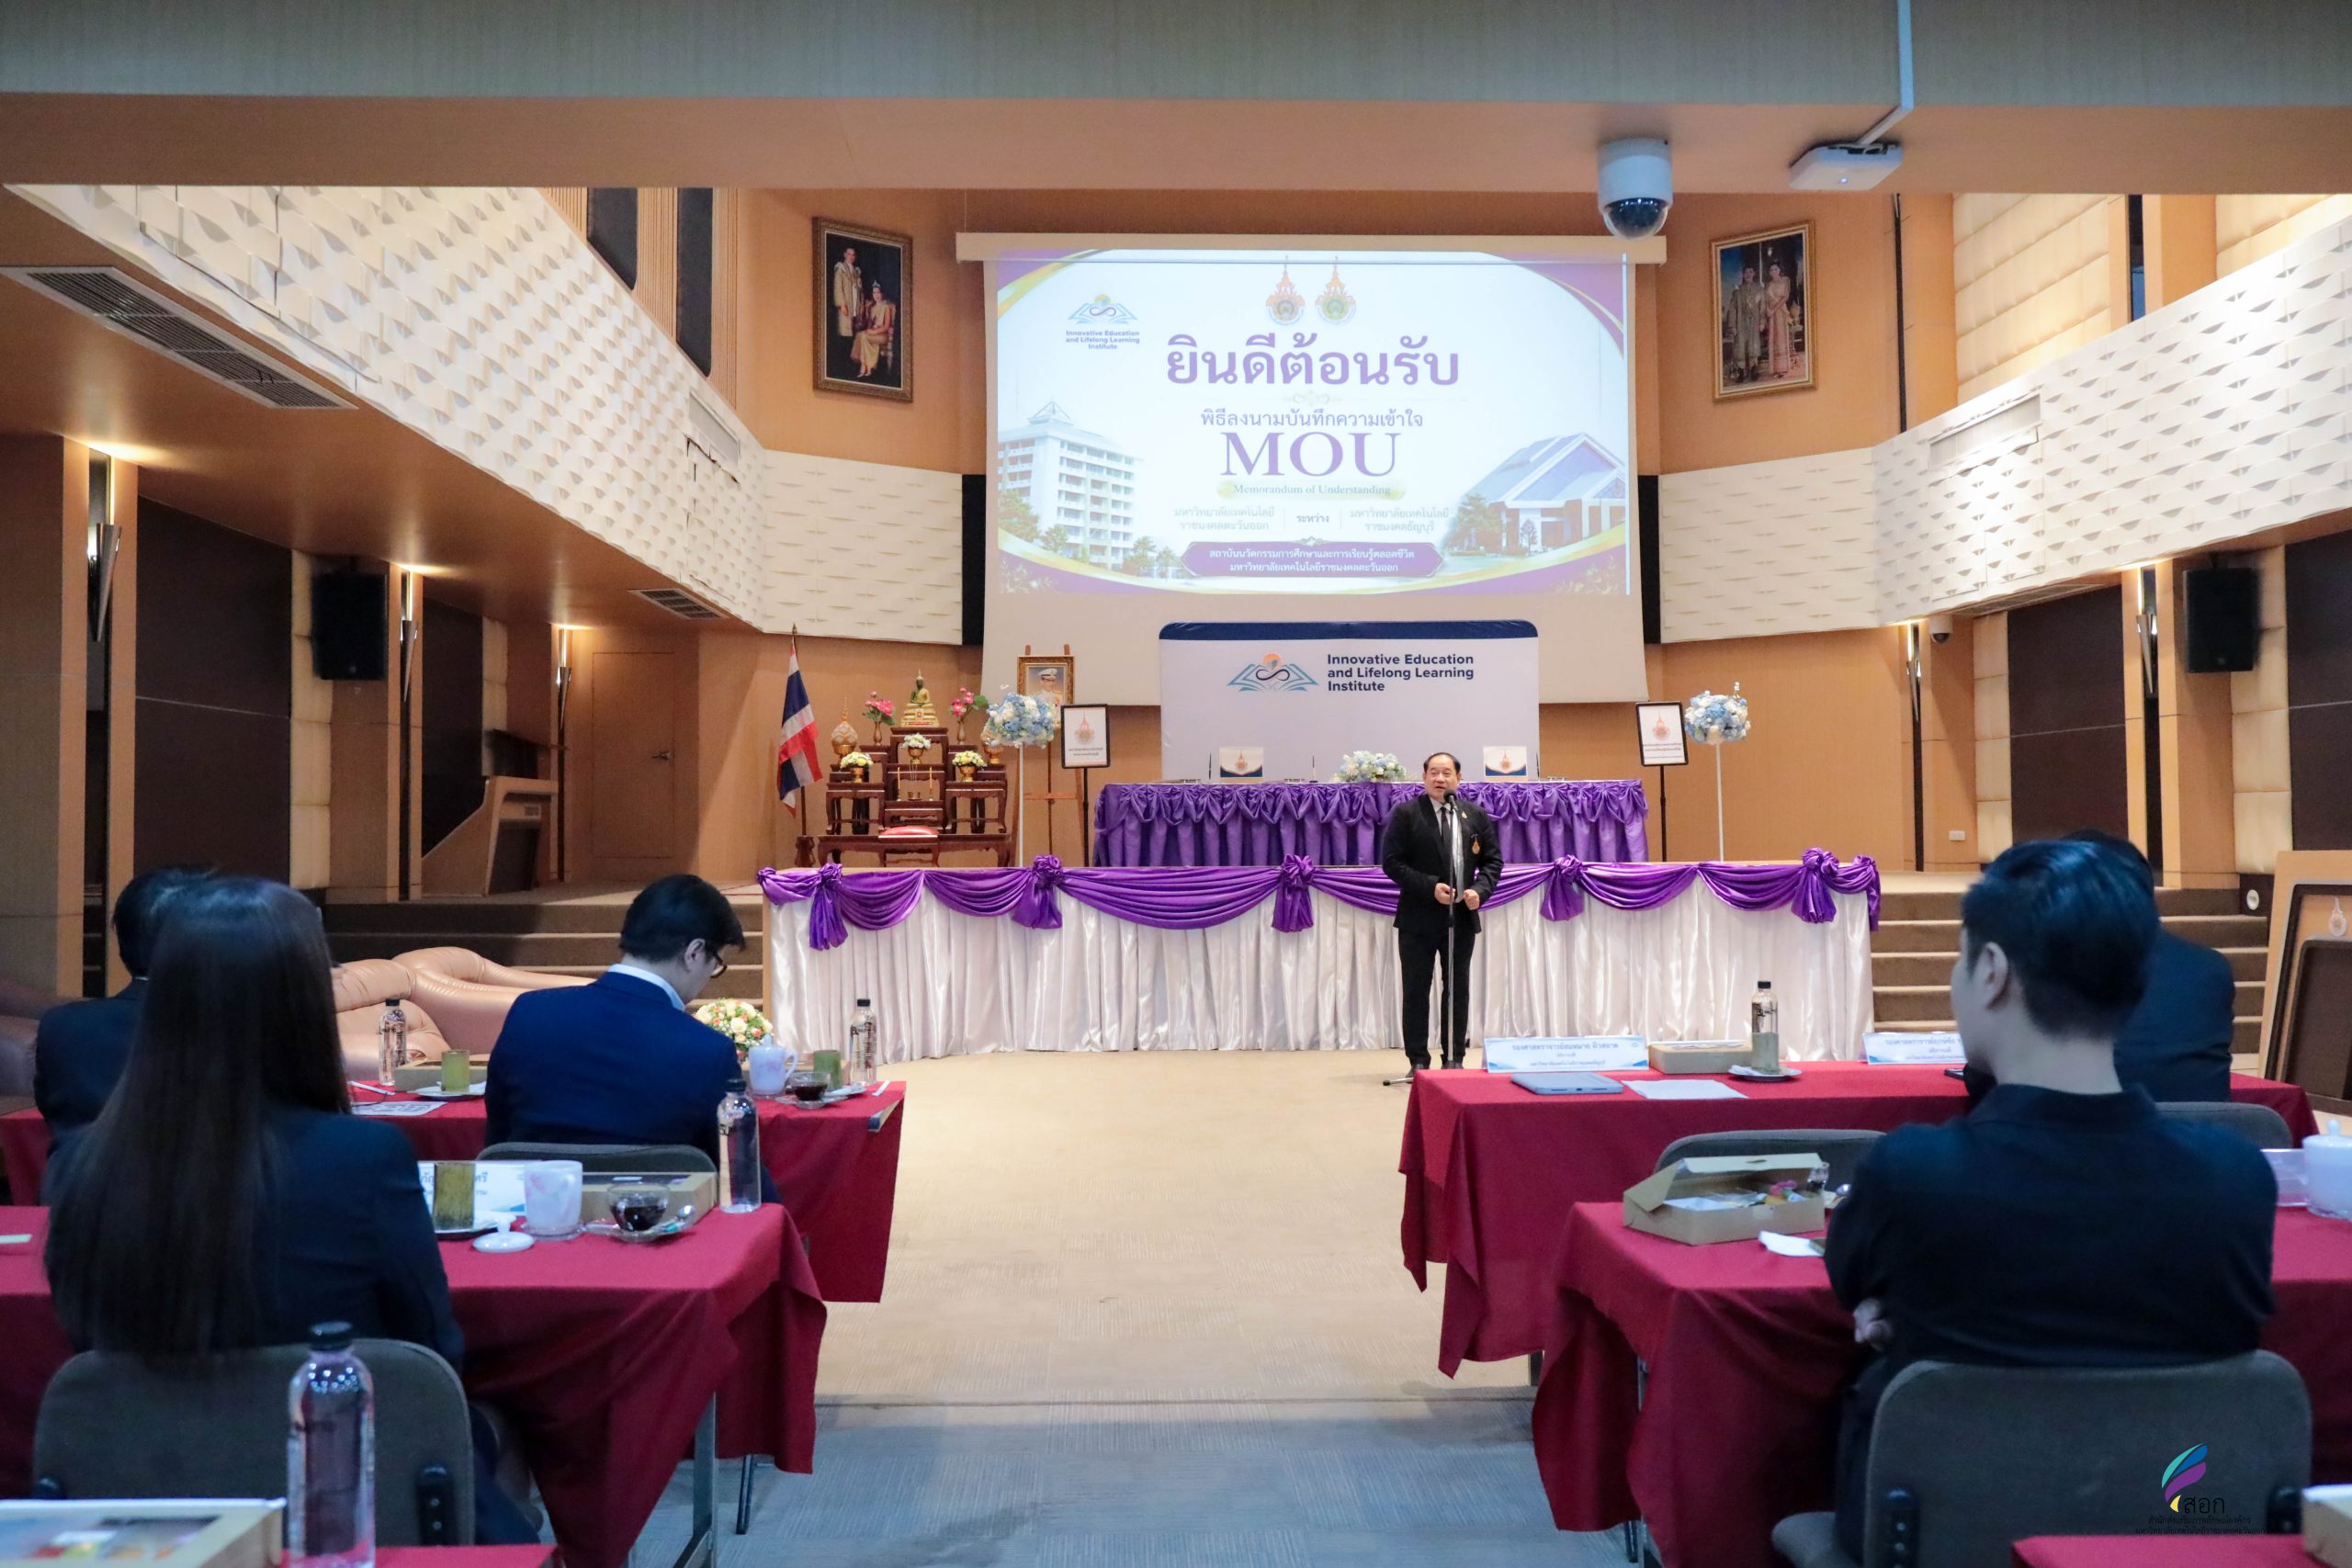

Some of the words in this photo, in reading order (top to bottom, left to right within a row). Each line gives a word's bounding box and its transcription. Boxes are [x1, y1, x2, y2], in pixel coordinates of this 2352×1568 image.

[1167, 332, 1459, 386] ยินดีต้อนรับ
[1201, 408, 1423, 427] พิธีลงนามบันทึกความเข้าใจ
[1220, 432, 1402, 477] MOU
[1233, 485, 1303, 494] Memorandum
[1306, 484, 1317, 494] of
[1318, 484, 1391, 496] Understanding
[1296, 513, 1329, 523] ระหว่าง
[1209, 548, 1415, 560] สถาบันนวัตกรรมการศึกษาและการเรียนรู้ตลอดชีวิต
[1229, 561, 1398, 571] มหาวิทยาลัยเทคโนโลยีราชมงคลตะวันออก
[1328, 654, 1400, 664] Innovative
[1405, 654, 1474, 664] Education
[1328, 668, 1352, 678] and
[1357, 667, 1411, 680] Lifelong
[1415, 667, 1474, 680] Learning
[1328, 681, 1385, 691] Institute
